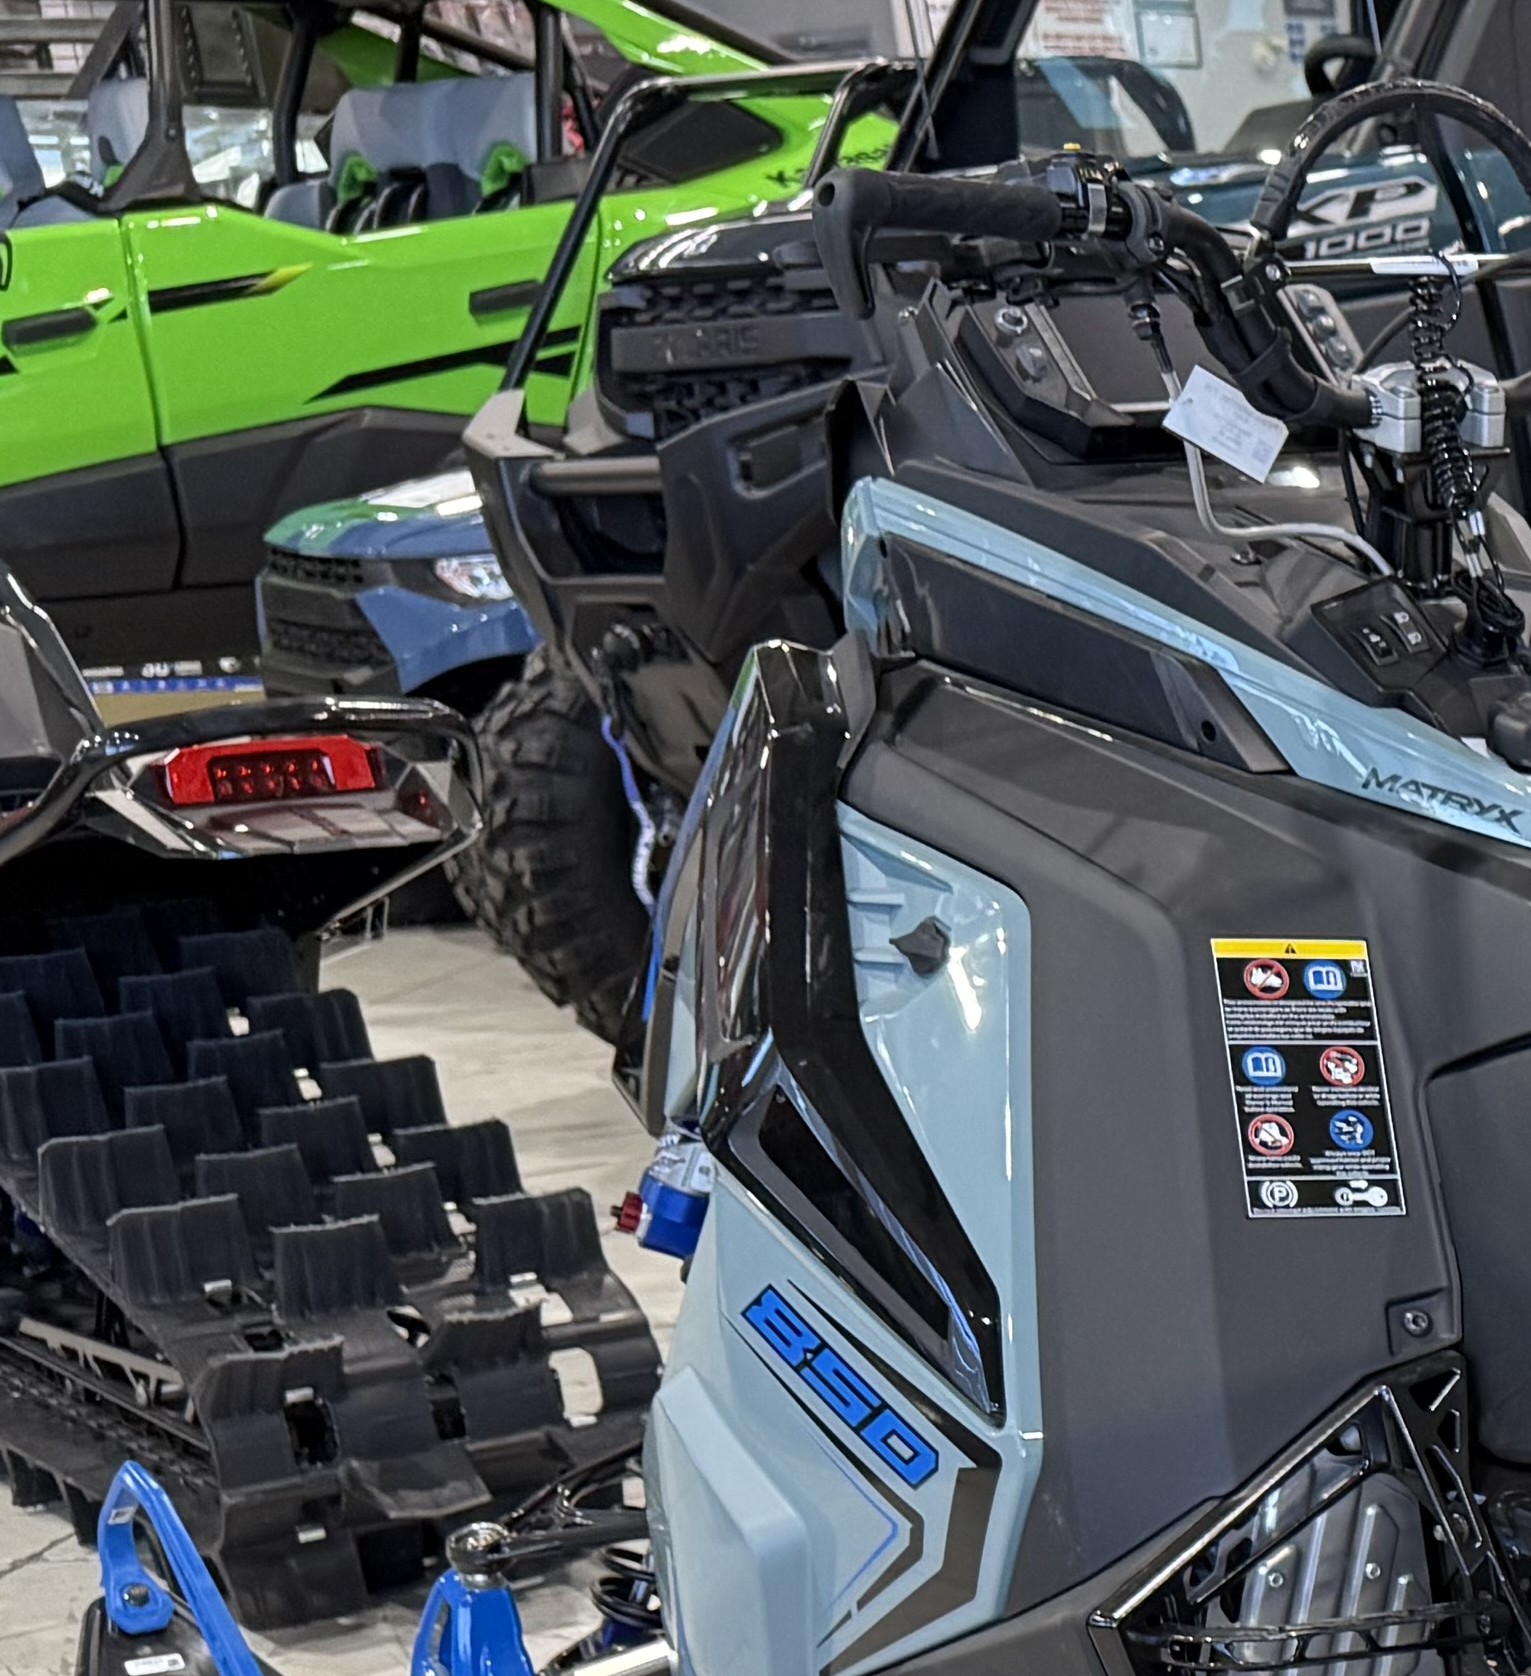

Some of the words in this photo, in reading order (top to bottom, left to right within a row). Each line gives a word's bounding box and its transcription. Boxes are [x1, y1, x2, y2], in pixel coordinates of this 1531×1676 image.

[1289, 178, 1435, 232] XP
[1304, 218, 1430, 259] 1000
[1361, 767, 1525, 835] MATRYX
[741, 1283, 939, 1490] 850
